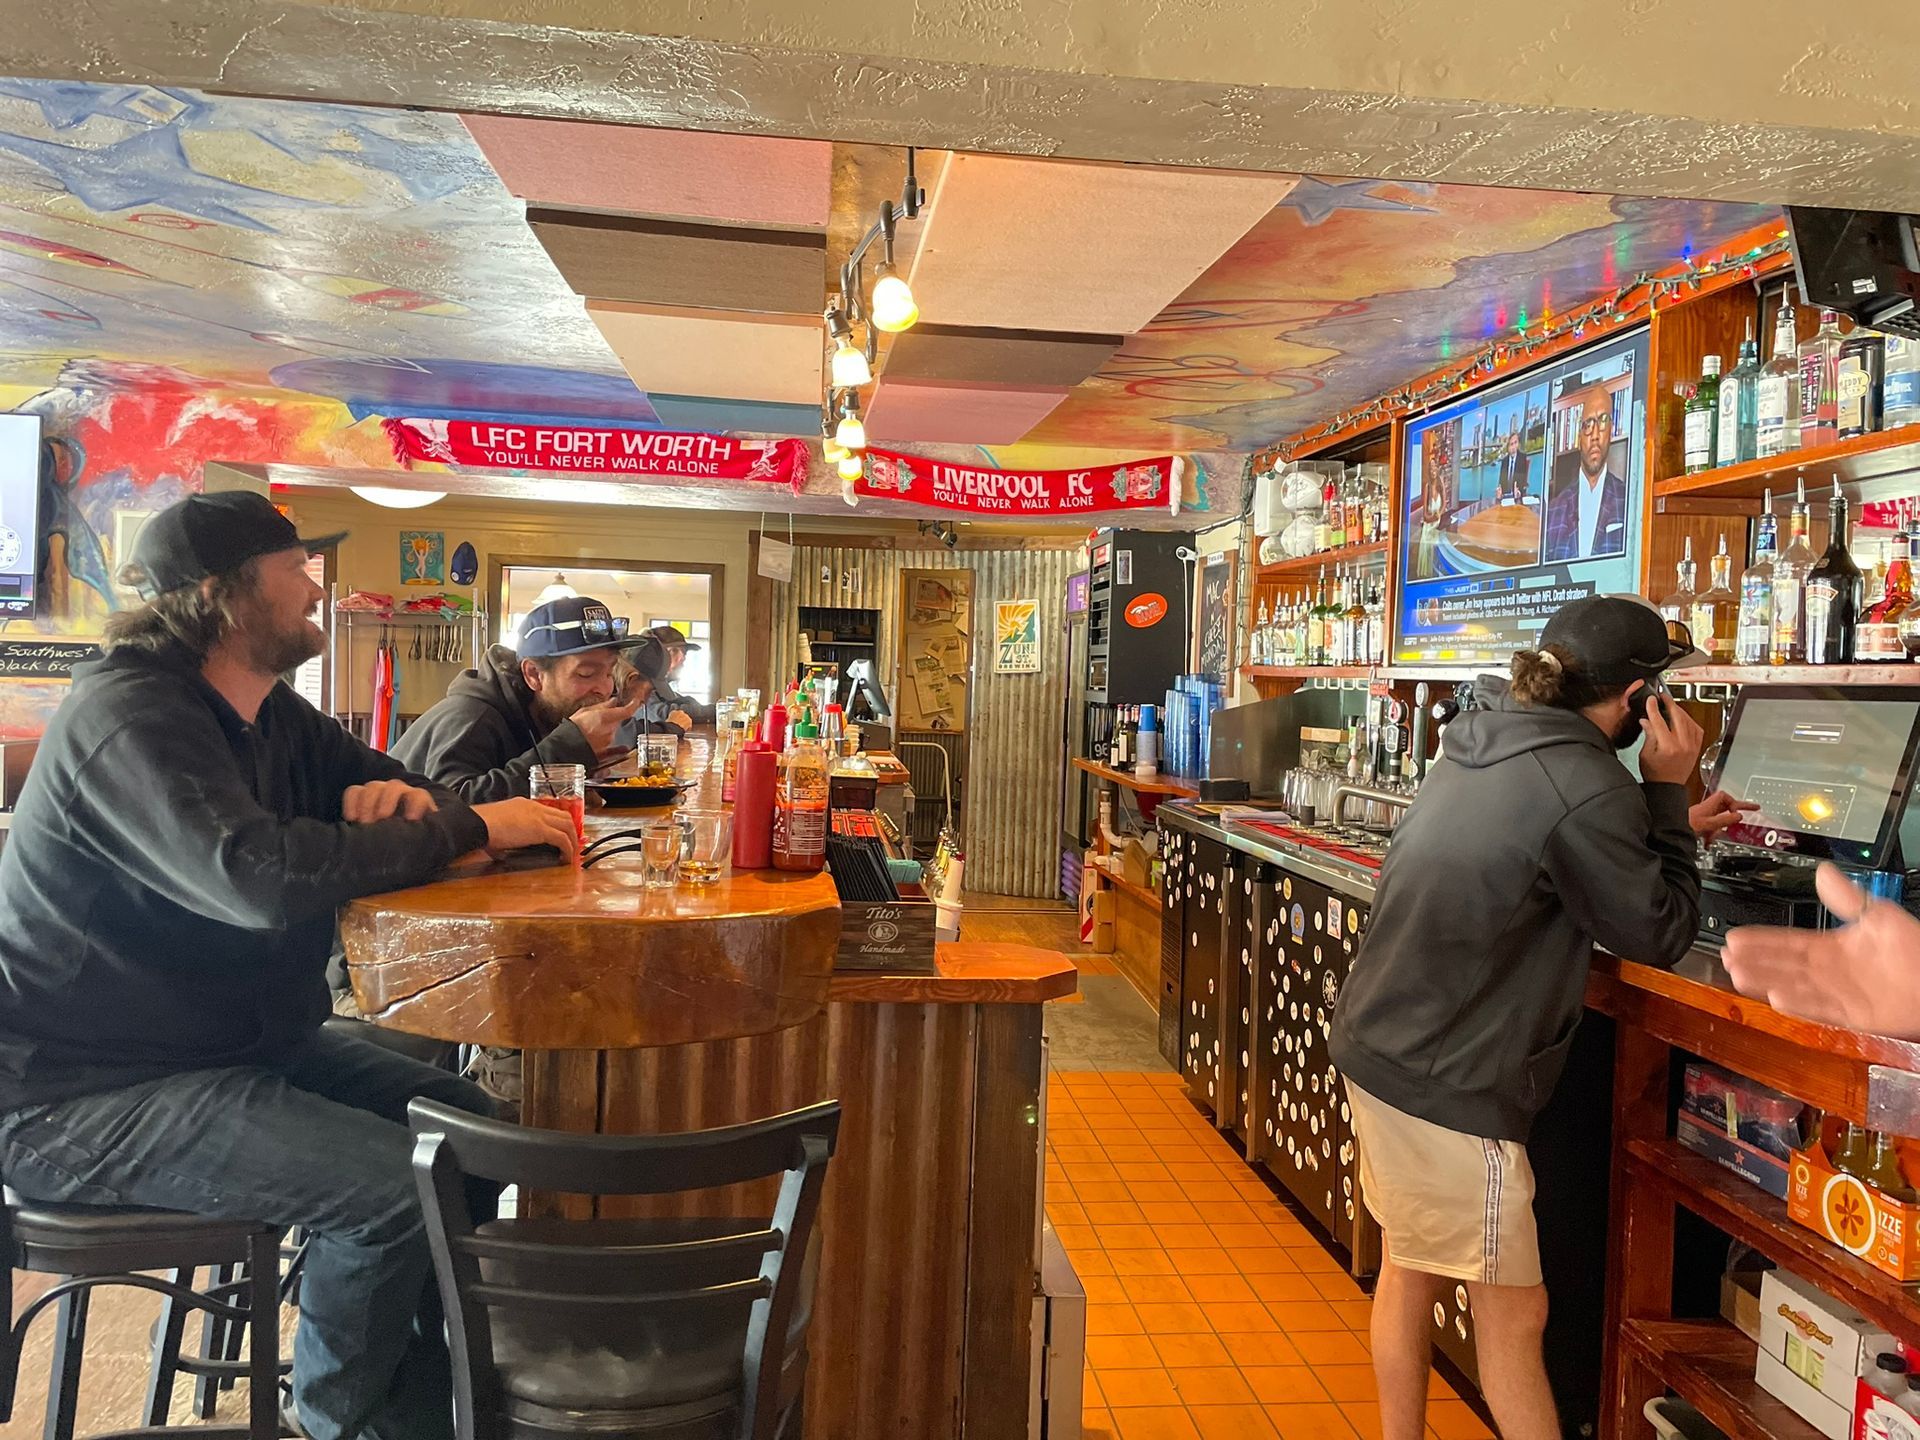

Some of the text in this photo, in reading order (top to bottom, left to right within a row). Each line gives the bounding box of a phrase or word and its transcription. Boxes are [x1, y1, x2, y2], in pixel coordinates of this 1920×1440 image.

[471, 426, 731, 461] LFC FORT WORTH
[483, 449, 719, 475] YOU'LL NEVER WALK ALONE
[933, 465, 1094, 498] LIVERPOOL FC
[933, 489, 1094, 509] YOU'LL NEVER WALK ALONE
[1542, 590, 1552, 602] NFL
[4, 644, 95, 659] Southwest
[866, 906, 903, 920] Tito's
[859, 942, 906, 954] Handmade
[1878, 1210, 1903, 1237] IZZE
